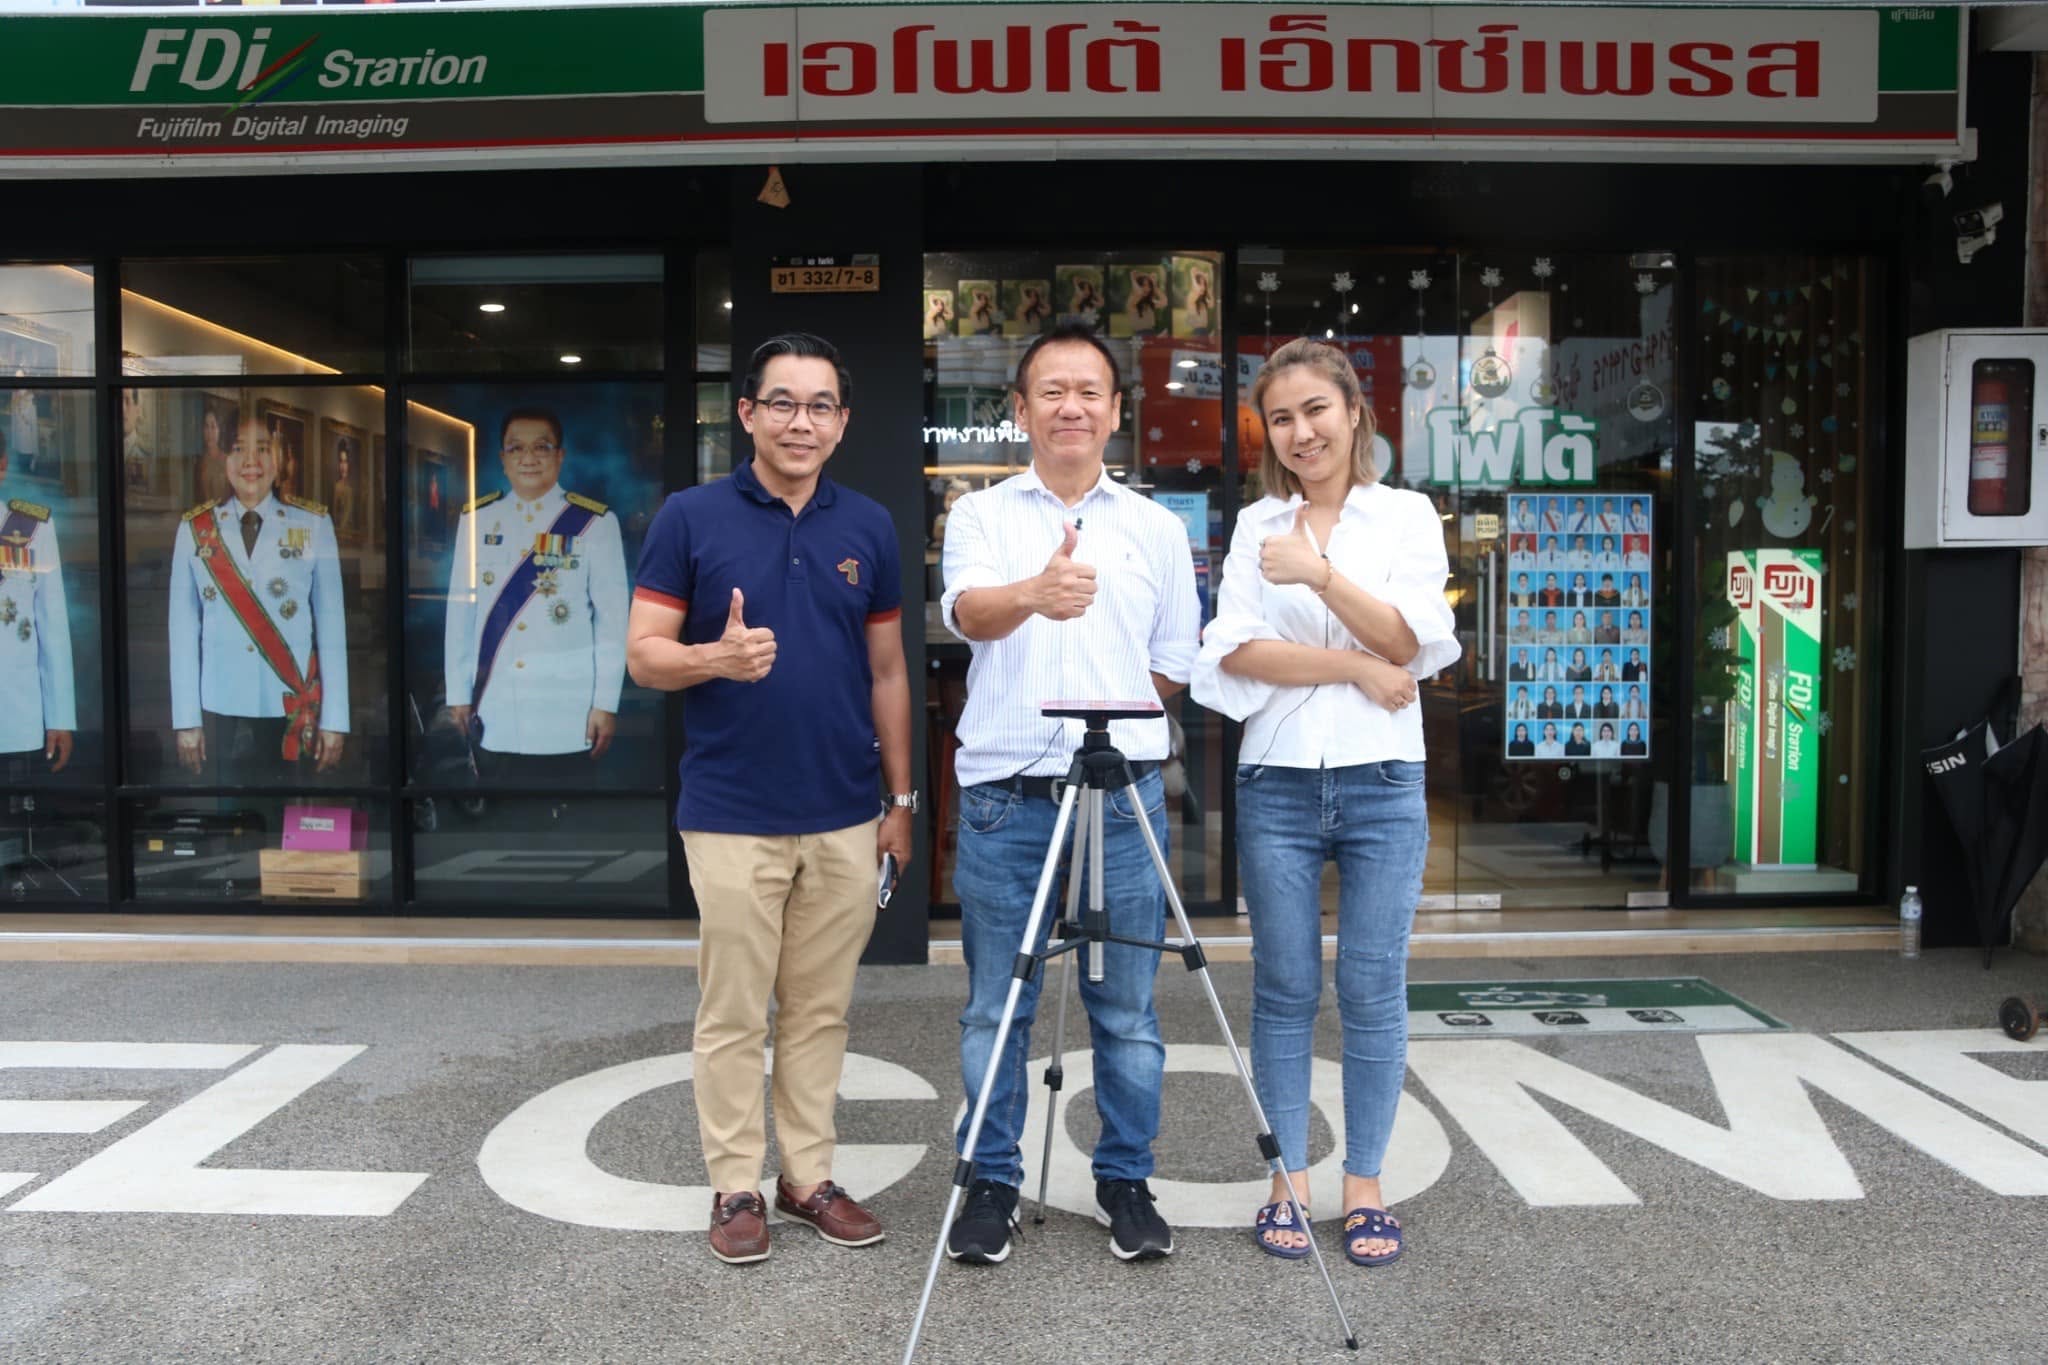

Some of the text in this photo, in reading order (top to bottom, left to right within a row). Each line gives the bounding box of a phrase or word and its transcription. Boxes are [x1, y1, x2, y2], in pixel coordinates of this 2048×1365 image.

[129, 27, 272, 92] FDi
[763, 14, 1820, 98] เอโฟโต้ เอ็กซ์เพรส
[136, 113, 409, 142] Fujifilm Digital Imaging
[802, 268, 875, 286] 332/7-8
